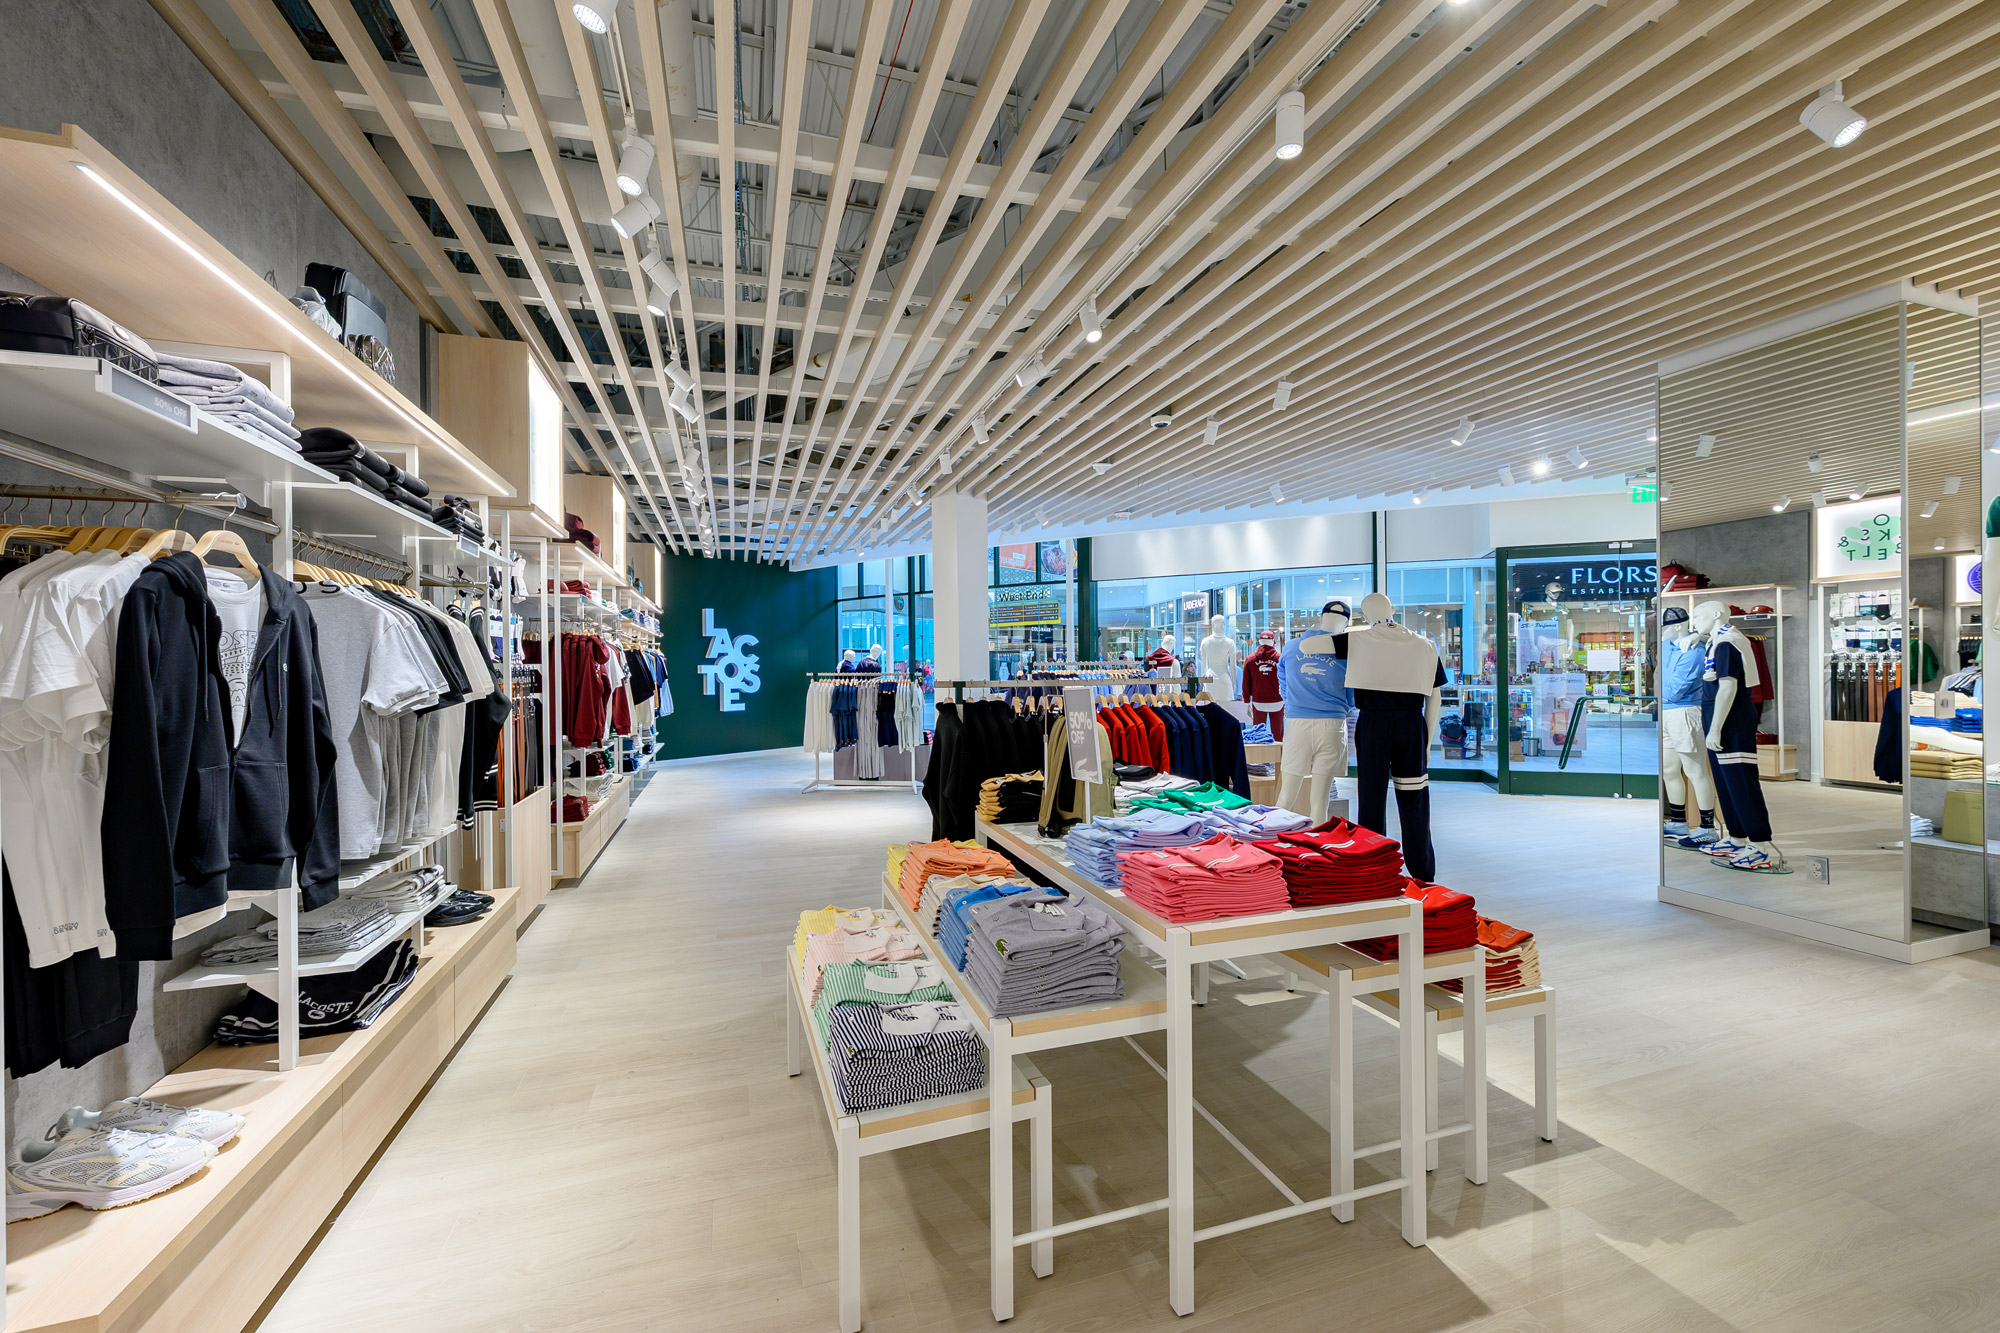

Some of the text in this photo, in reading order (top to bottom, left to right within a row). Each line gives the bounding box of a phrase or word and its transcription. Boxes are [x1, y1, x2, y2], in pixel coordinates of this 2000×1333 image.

[155, 397, 187, 418] 50% OFF
[1571, 565, 1658, 584] FLORS
[1000, 590, 1045, 602] West End
[1068, 711, 1093, 730] 50%
[1070, 730, 1085, 745] OFF
[298, 990, 354, 1014] LACOSTE
